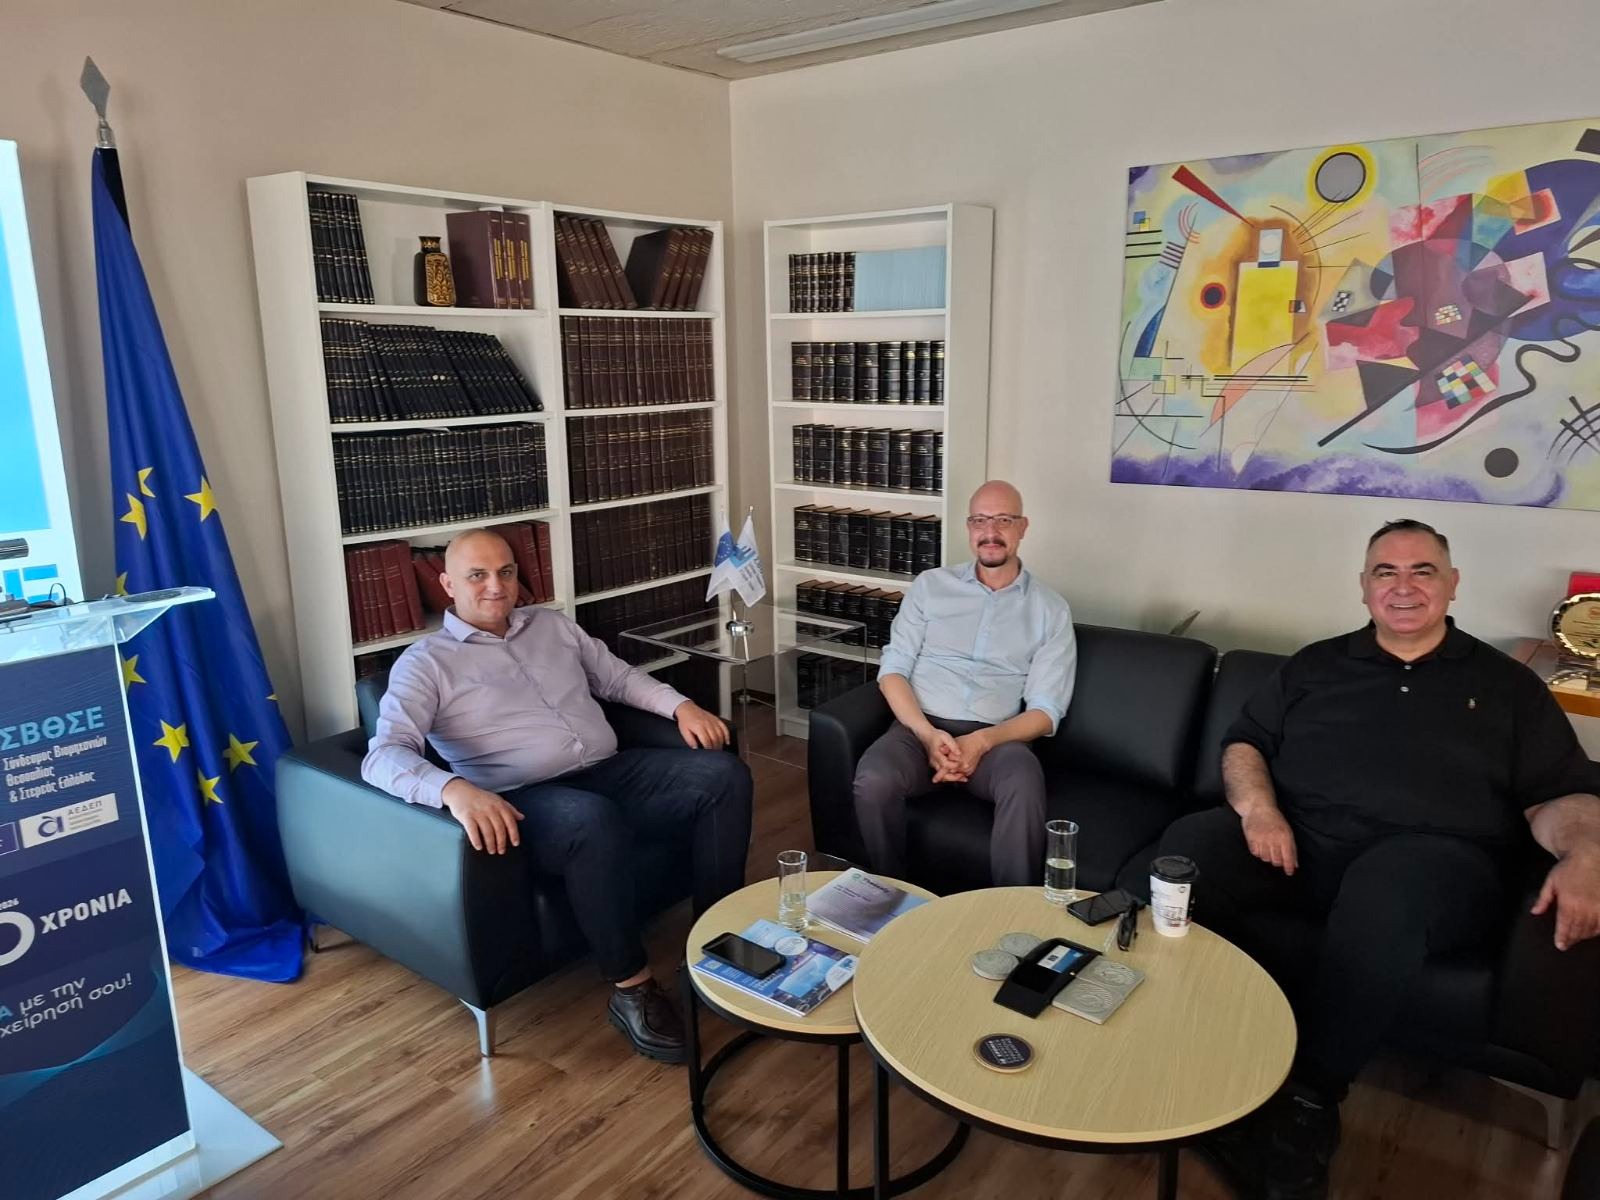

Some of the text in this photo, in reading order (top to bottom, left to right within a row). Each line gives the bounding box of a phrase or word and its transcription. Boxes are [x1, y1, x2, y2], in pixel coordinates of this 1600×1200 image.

[0, 706, 105, 751] ΣΒΘΣΕ
[9, 790, 18, 803] &
[40, 888, 133, 934] ΧΡΟΝΙΑ
[19, 994, 46, 1015] με
[50, 977, 86, 998] την
[88, 972, 132, 1000] σου!
